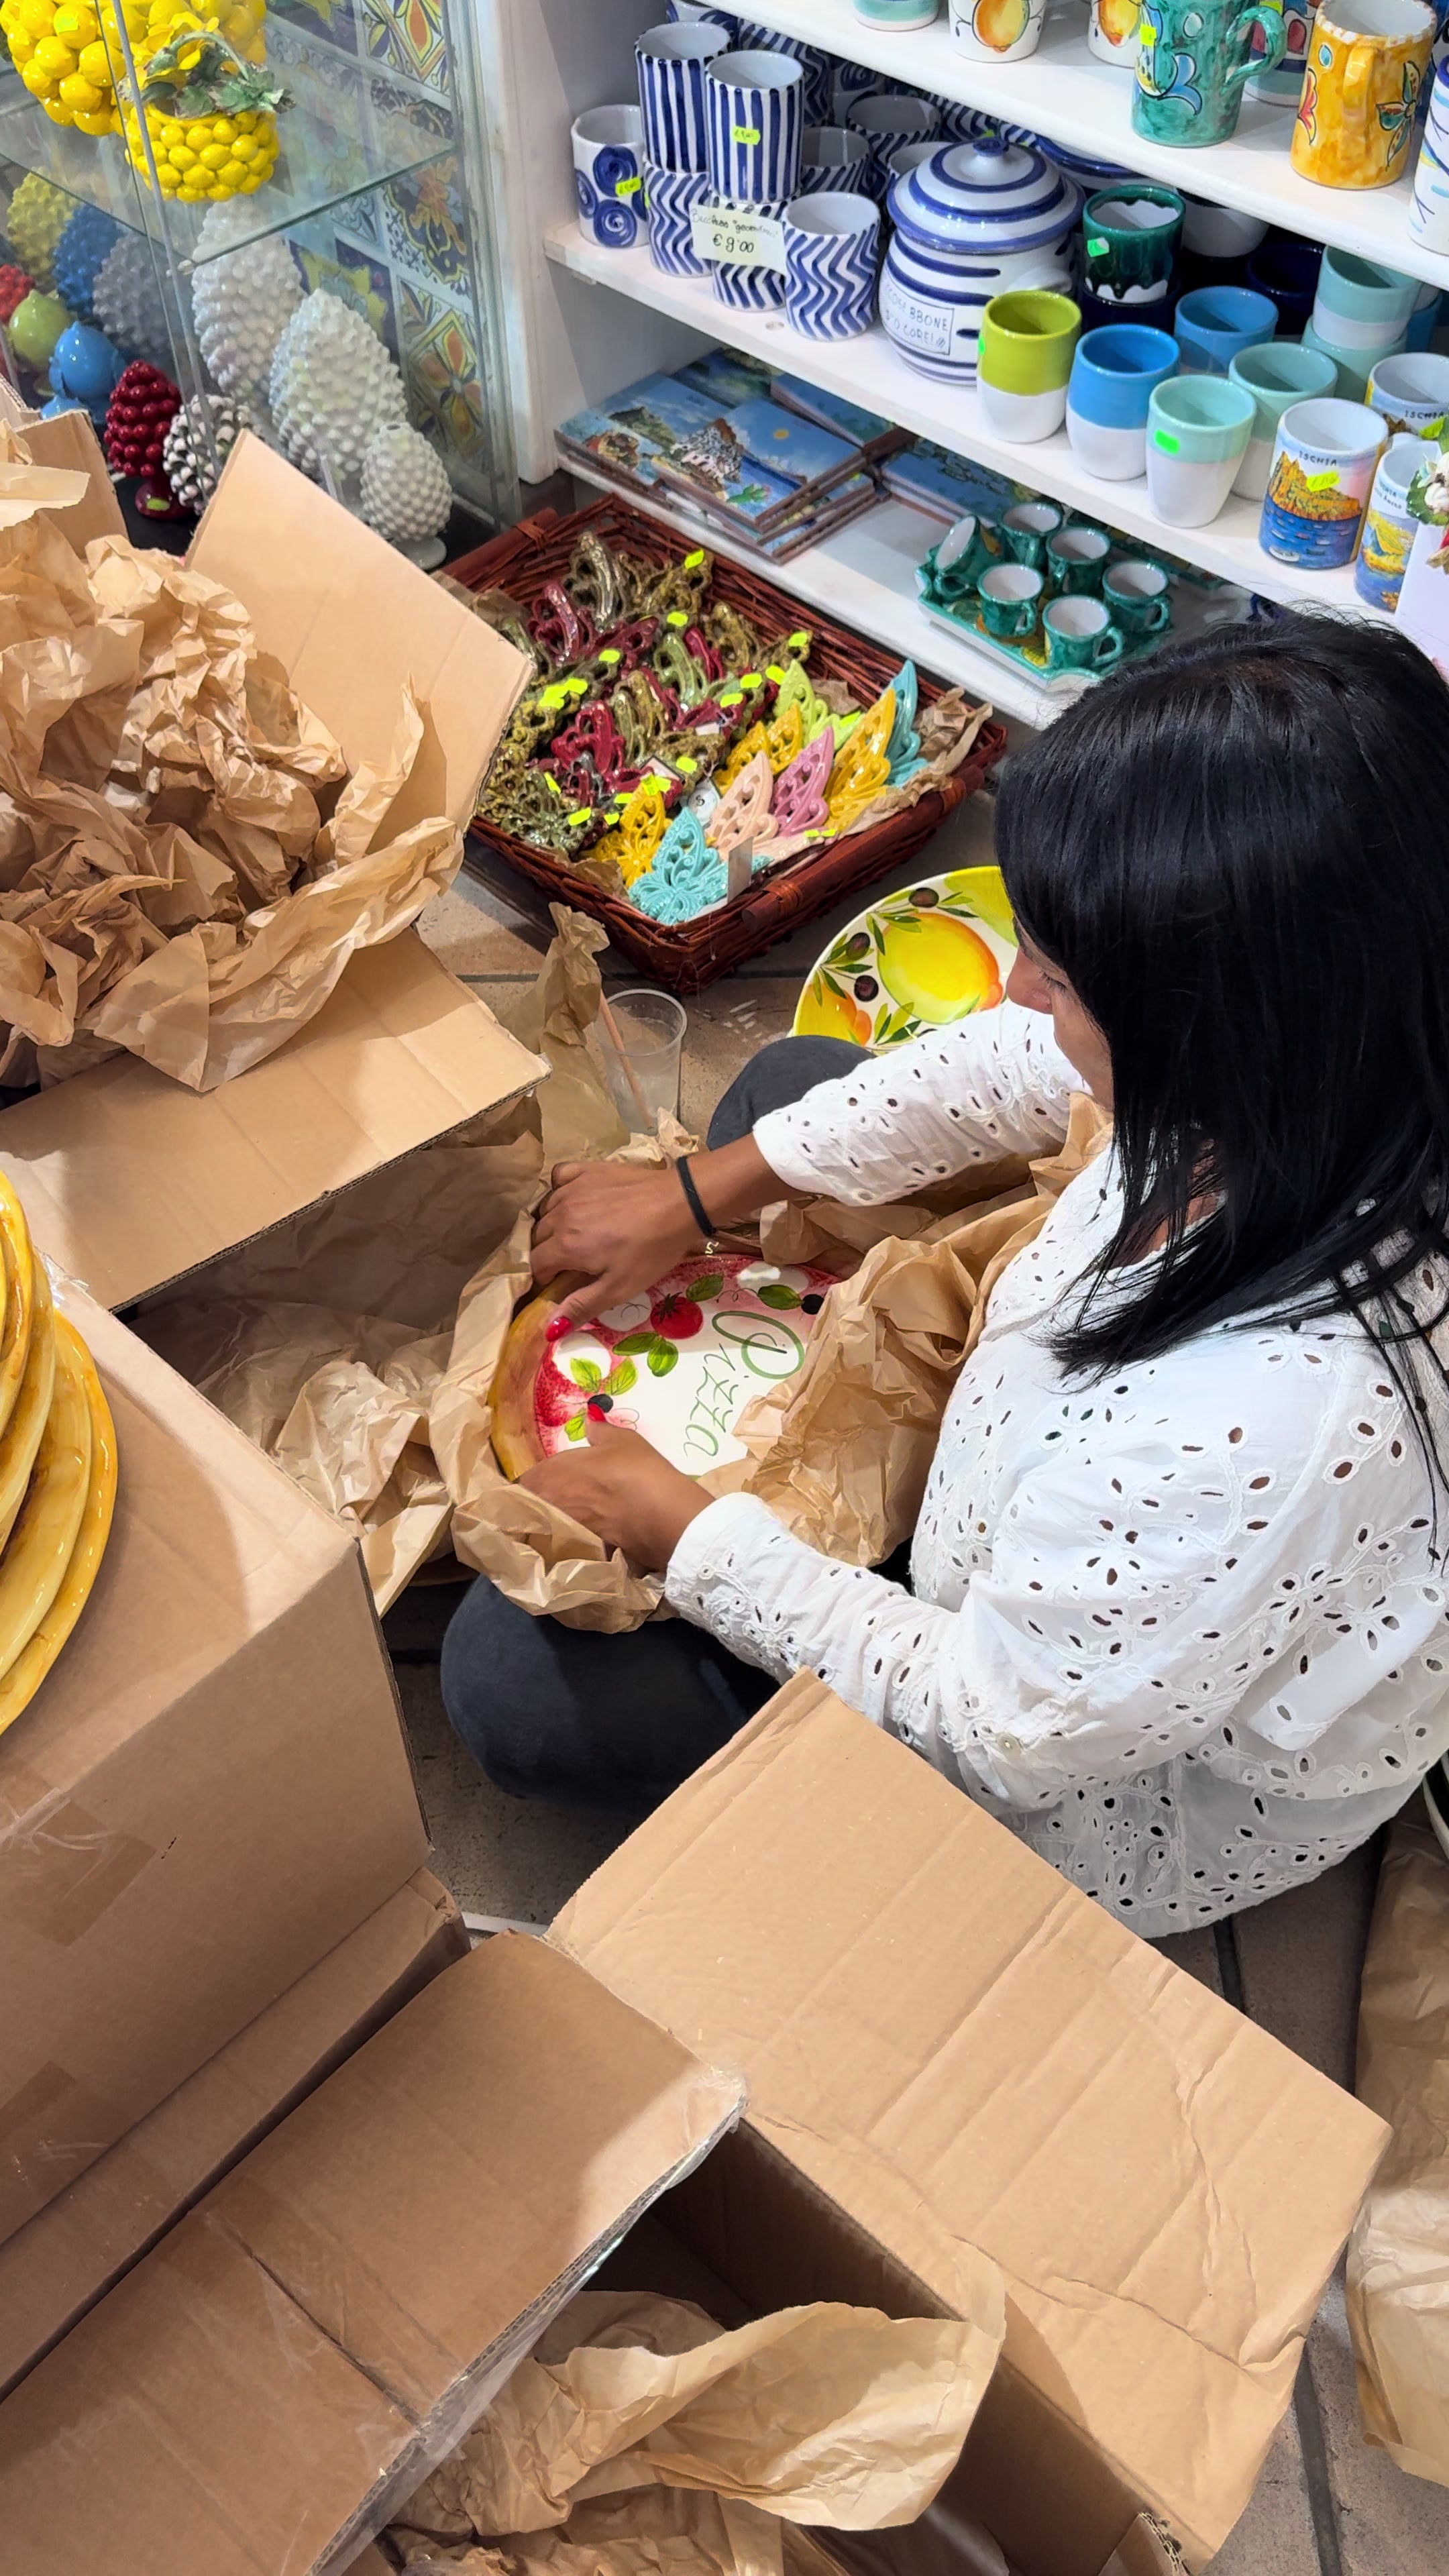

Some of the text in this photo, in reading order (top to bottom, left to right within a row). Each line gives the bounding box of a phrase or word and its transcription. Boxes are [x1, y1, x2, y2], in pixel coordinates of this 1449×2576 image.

[713, 233, 723, 247] €
[910, 307, 949, 332] BBONE
[1299, 450, 1338, 467] ISCHIA
[684, 1310, 806, 1457] Pizza
